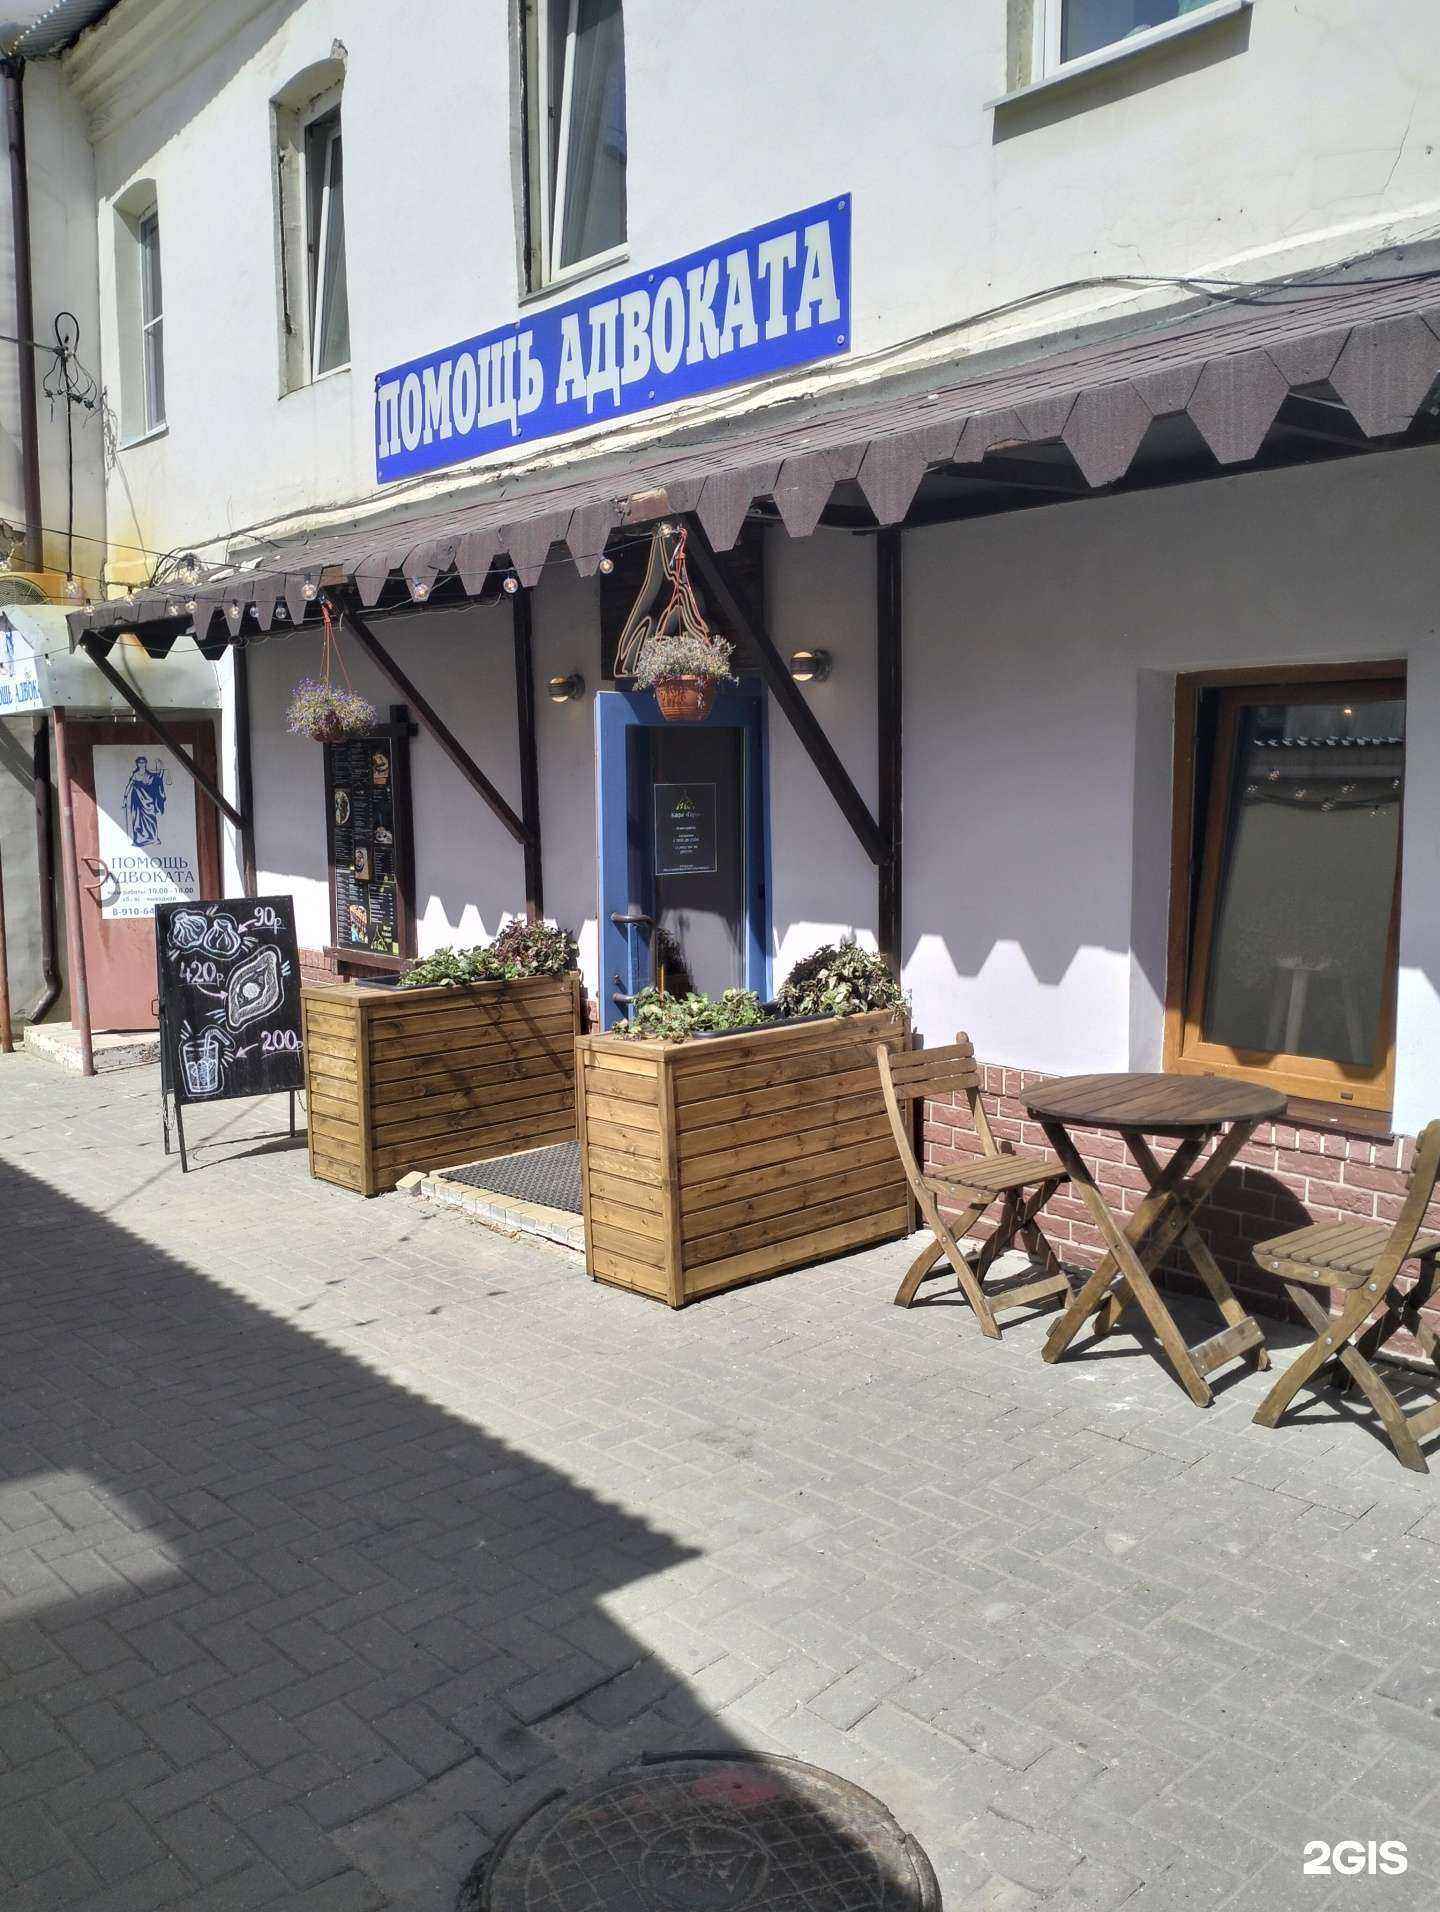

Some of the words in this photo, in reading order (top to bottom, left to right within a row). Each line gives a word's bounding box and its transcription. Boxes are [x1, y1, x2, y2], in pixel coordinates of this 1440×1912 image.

[377, 329, 544, 458] ПОМОЩЬ
[555, 220, 840, 414] АДВОКАТА
[112, 856, 188, 869] ПОМОЩЬ
